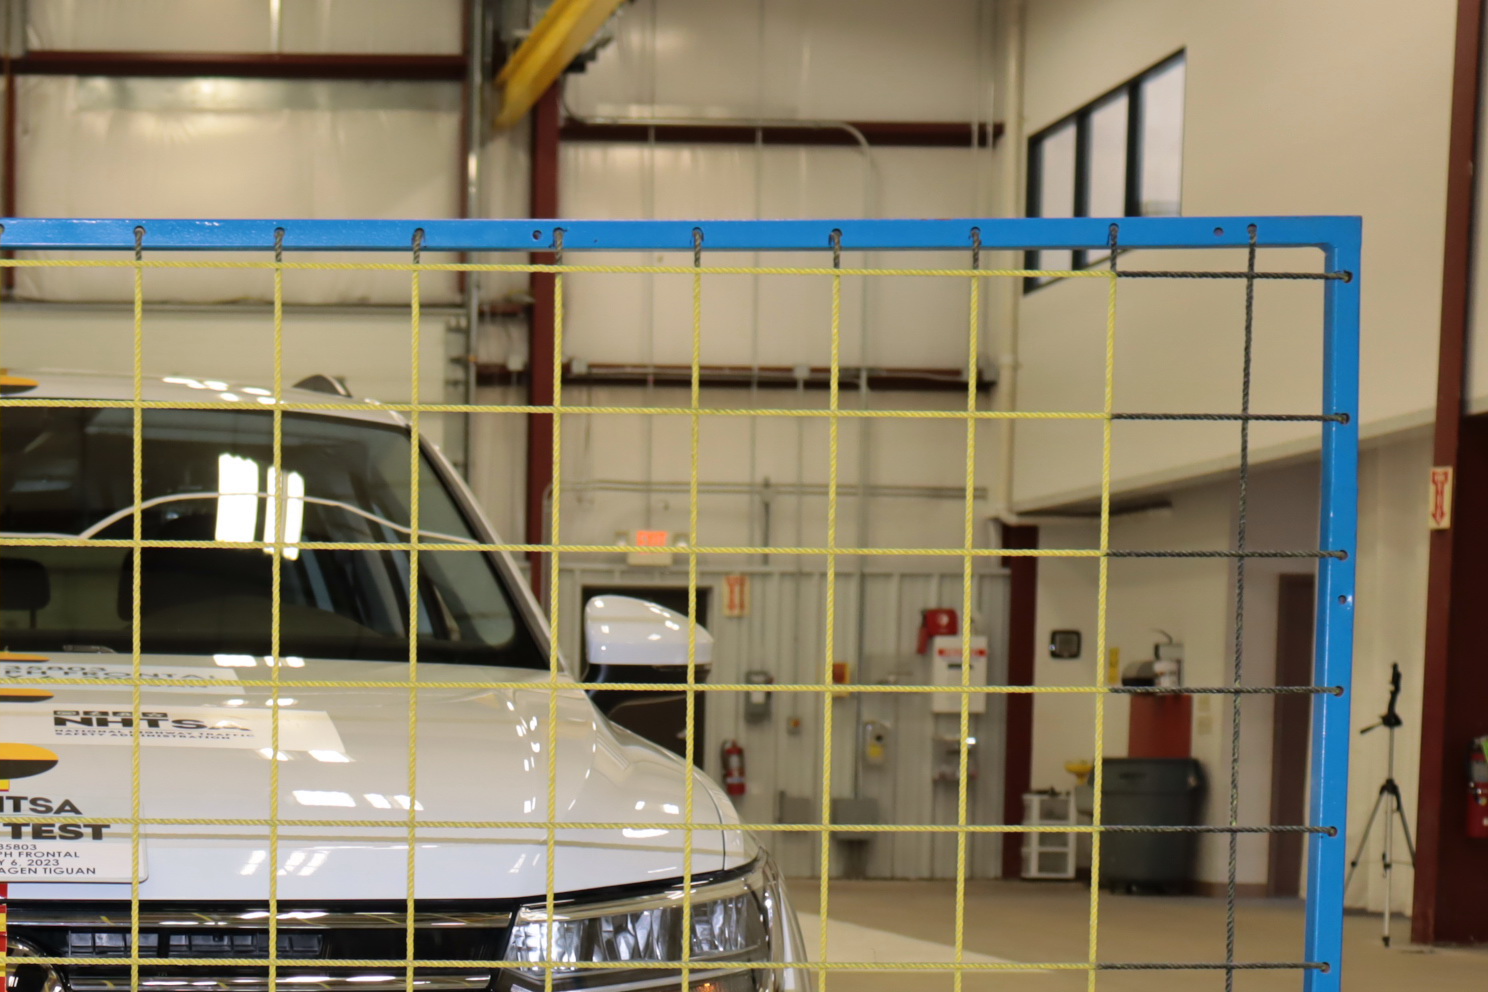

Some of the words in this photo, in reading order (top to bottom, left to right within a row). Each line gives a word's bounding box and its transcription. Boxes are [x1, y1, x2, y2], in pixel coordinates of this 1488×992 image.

[2, 822, 111, 841] TEST
[27, 859, 60, 867] 2023
[42, 867, 97, 875] TIGUAN
